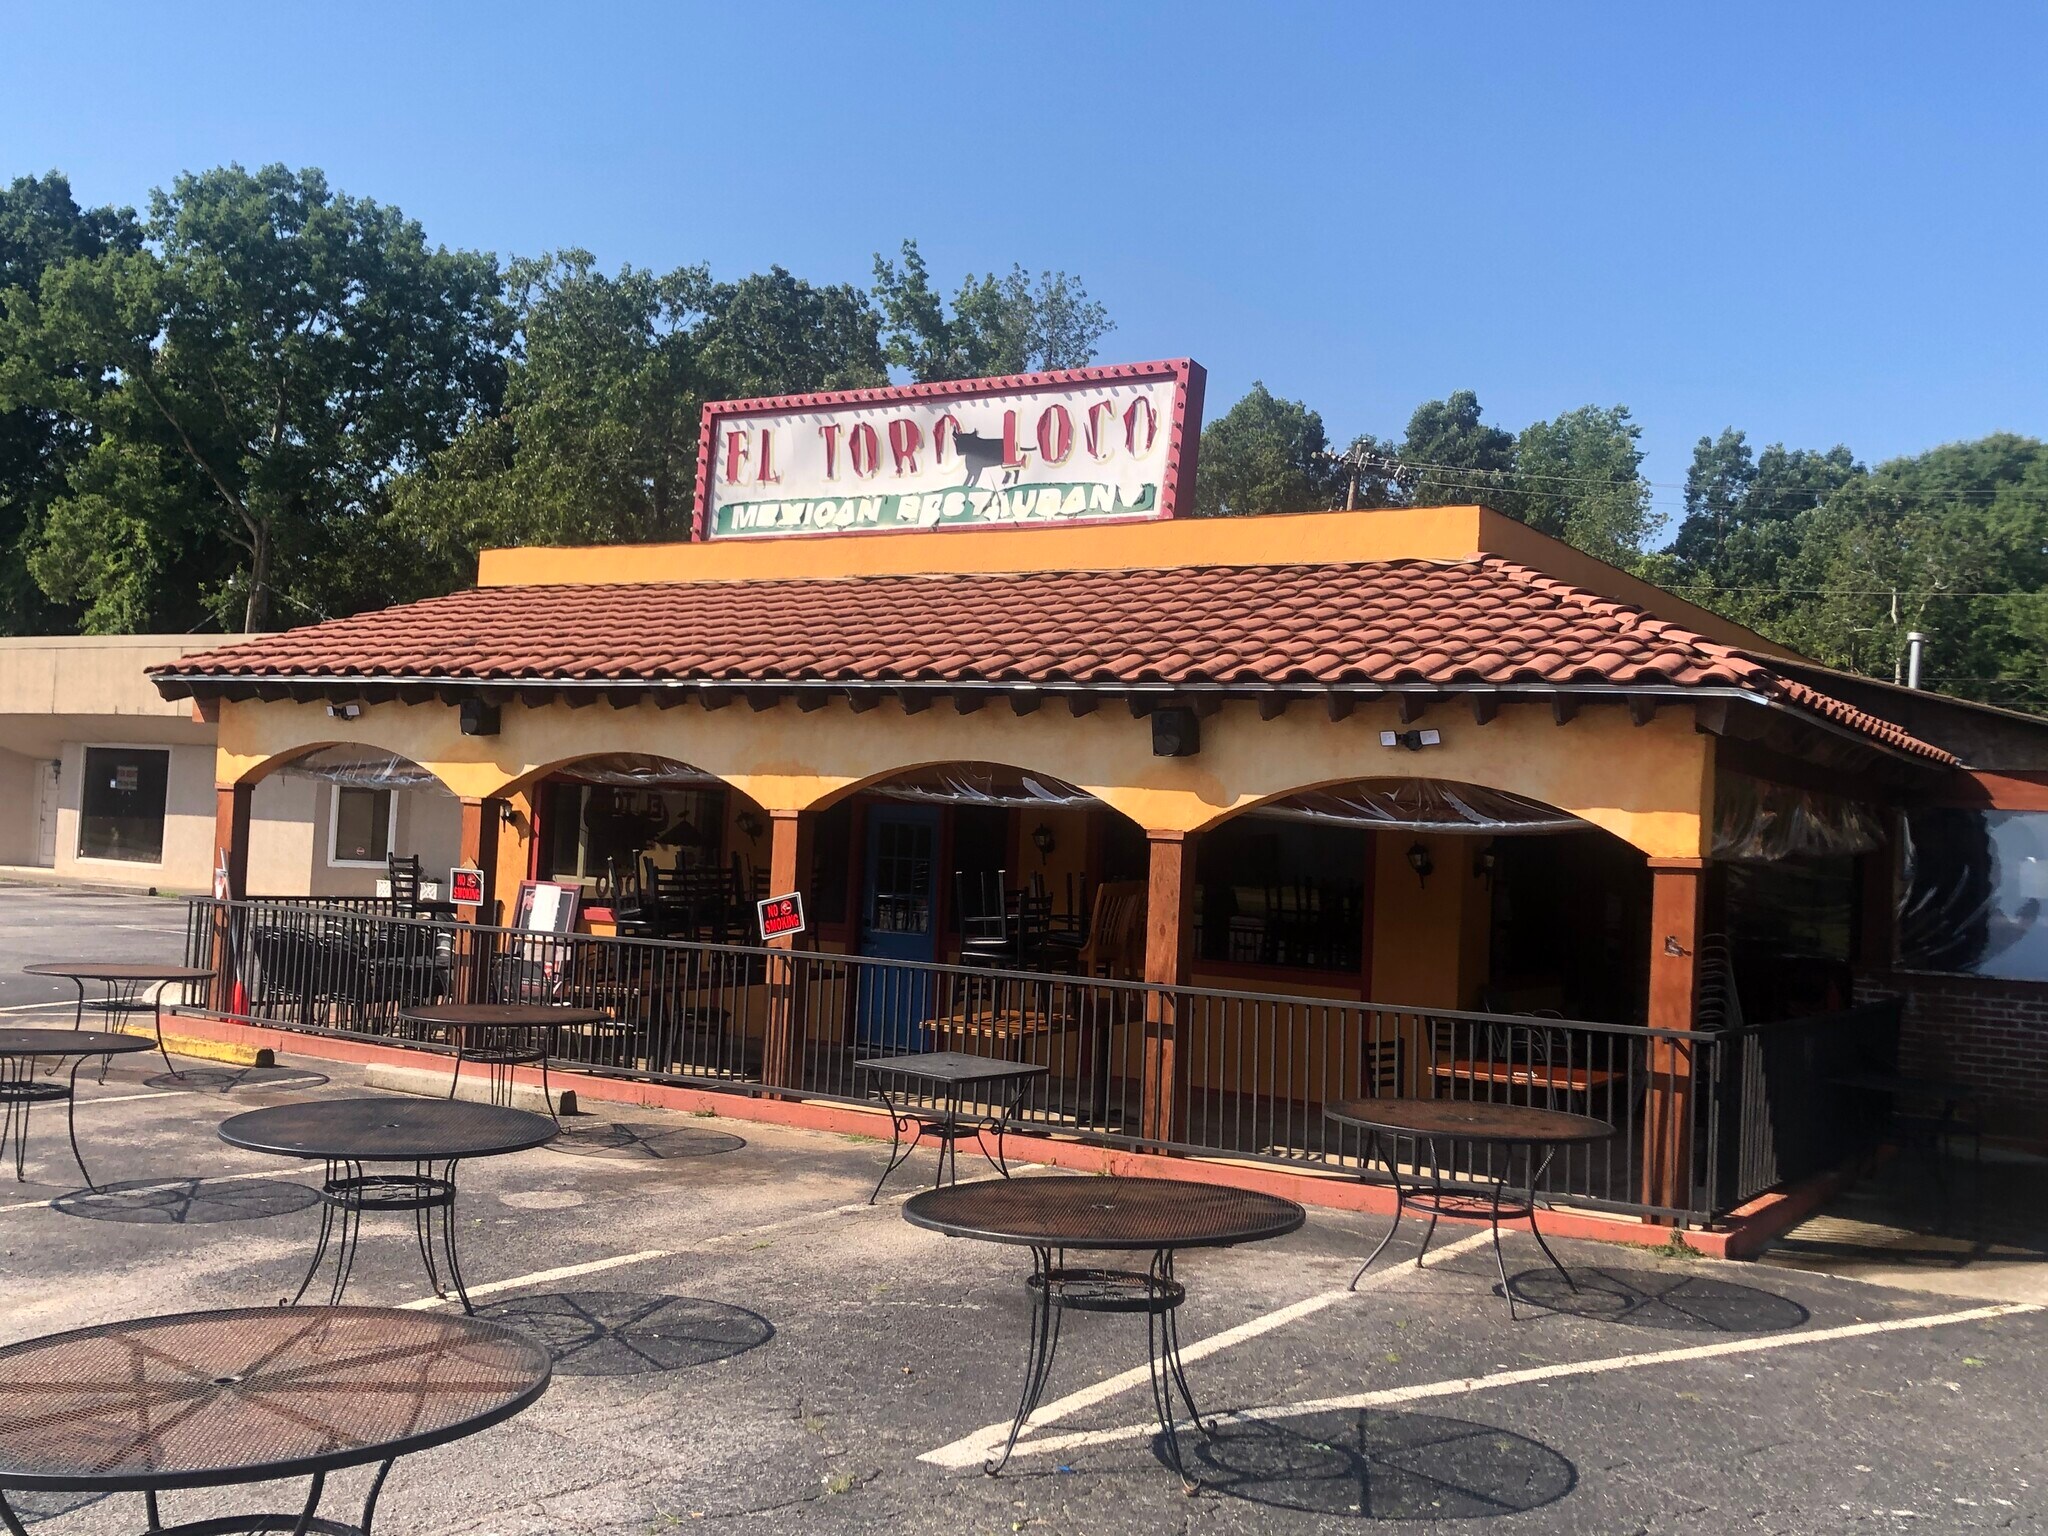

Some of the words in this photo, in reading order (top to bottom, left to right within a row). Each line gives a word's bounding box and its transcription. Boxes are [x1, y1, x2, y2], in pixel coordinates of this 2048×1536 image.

[724, 428, 783, 487] EL
[817, 412, 968, 484] TORO
[1001, 394, 1161, 471] LOCO
[731, 497, 883, 530] MEXICAN
[456, 873, 466, 886] NO
[453, 886, 480, 901] SMOKING
[767, 903, 779, 918] NO
[765, 913, 799, 934] SMOKING
